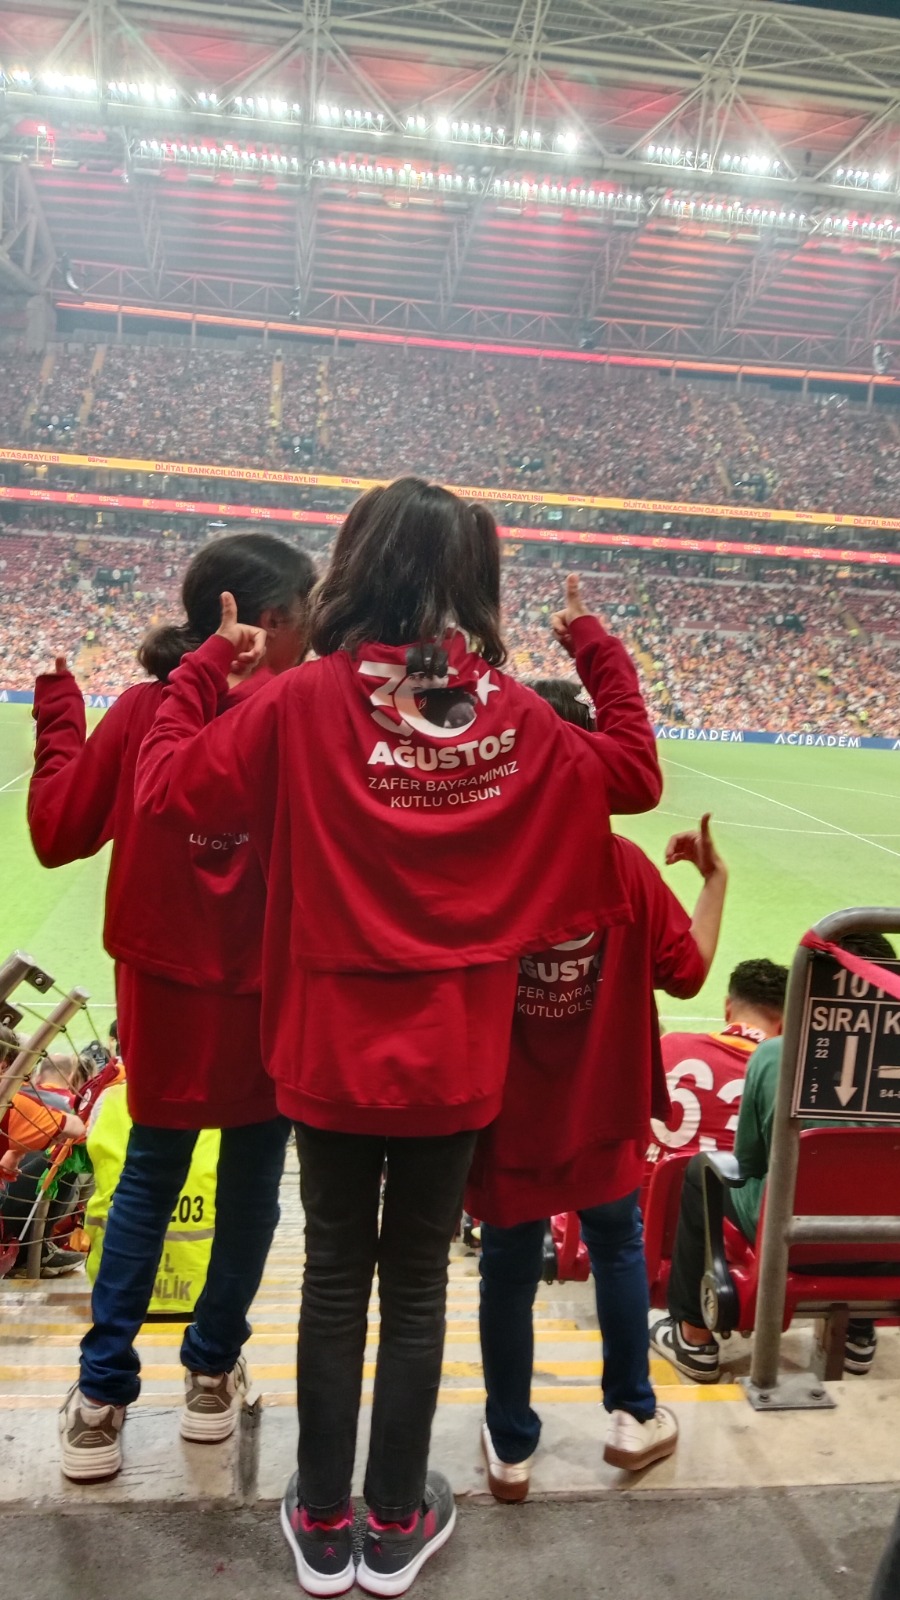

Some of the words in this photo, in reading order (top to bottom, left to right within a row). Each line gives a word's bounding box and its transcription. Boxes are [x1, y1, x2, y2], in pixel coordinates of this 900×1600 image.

[656, 727, 744, 742] ACIBADEM
[775, 733, 861, 748] ACIBADEM
[367, 729, 517, 772] AĞUSTOS
[368, 776, 421, 791] ZAFER
[425, 761, 520, 792] BAYRAMIMIZ
[391, 795, 443, 809] KUTLU
[447, 785, 501, 806] OLSUN
[517, 1002, 564, 1018] KUTLU
[811, 1006, 871, 1034] SIRA
[815, 1037, 830, 1047] 23
[814, 1049, 829, 1059] 22
[810, 1083, 819, 1093] 2
[171, 1196, 203, 1223] 03
